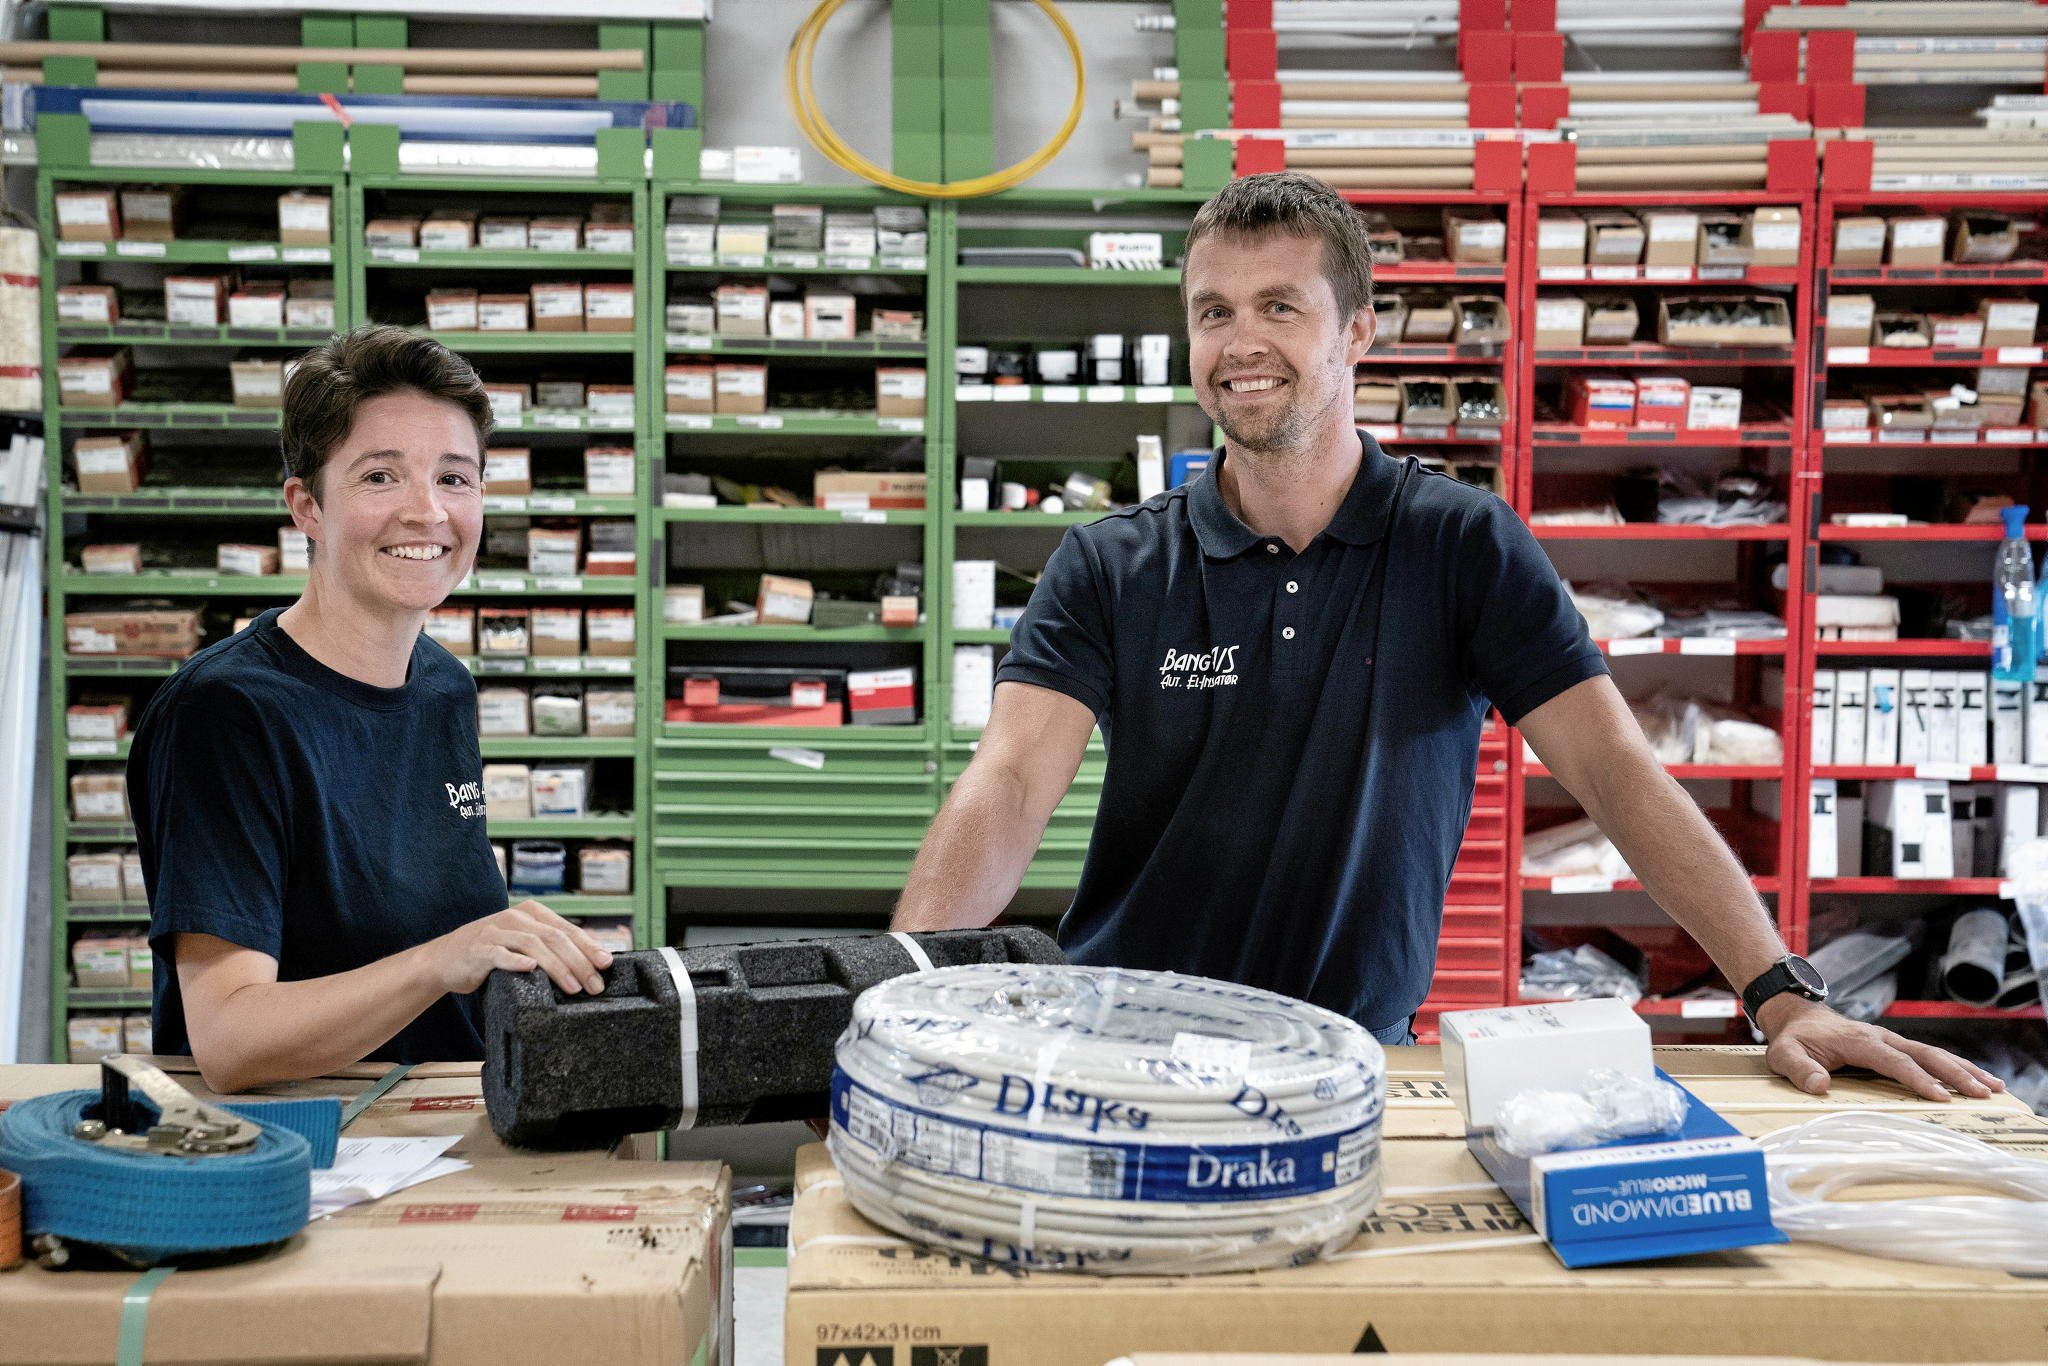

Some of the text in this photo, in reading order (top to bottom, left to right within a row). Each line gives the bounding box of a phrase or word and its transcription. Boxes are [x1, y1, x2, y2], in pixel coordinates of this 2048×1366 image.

[995, 1074, 1153, 1132] Draka
[1187, 1149, 1297, 1188] Draka
[1573, 1189, 1753, 1226] BLUEDIAMOND
[816, 1322, 942, 1343] 97x42x31cm
